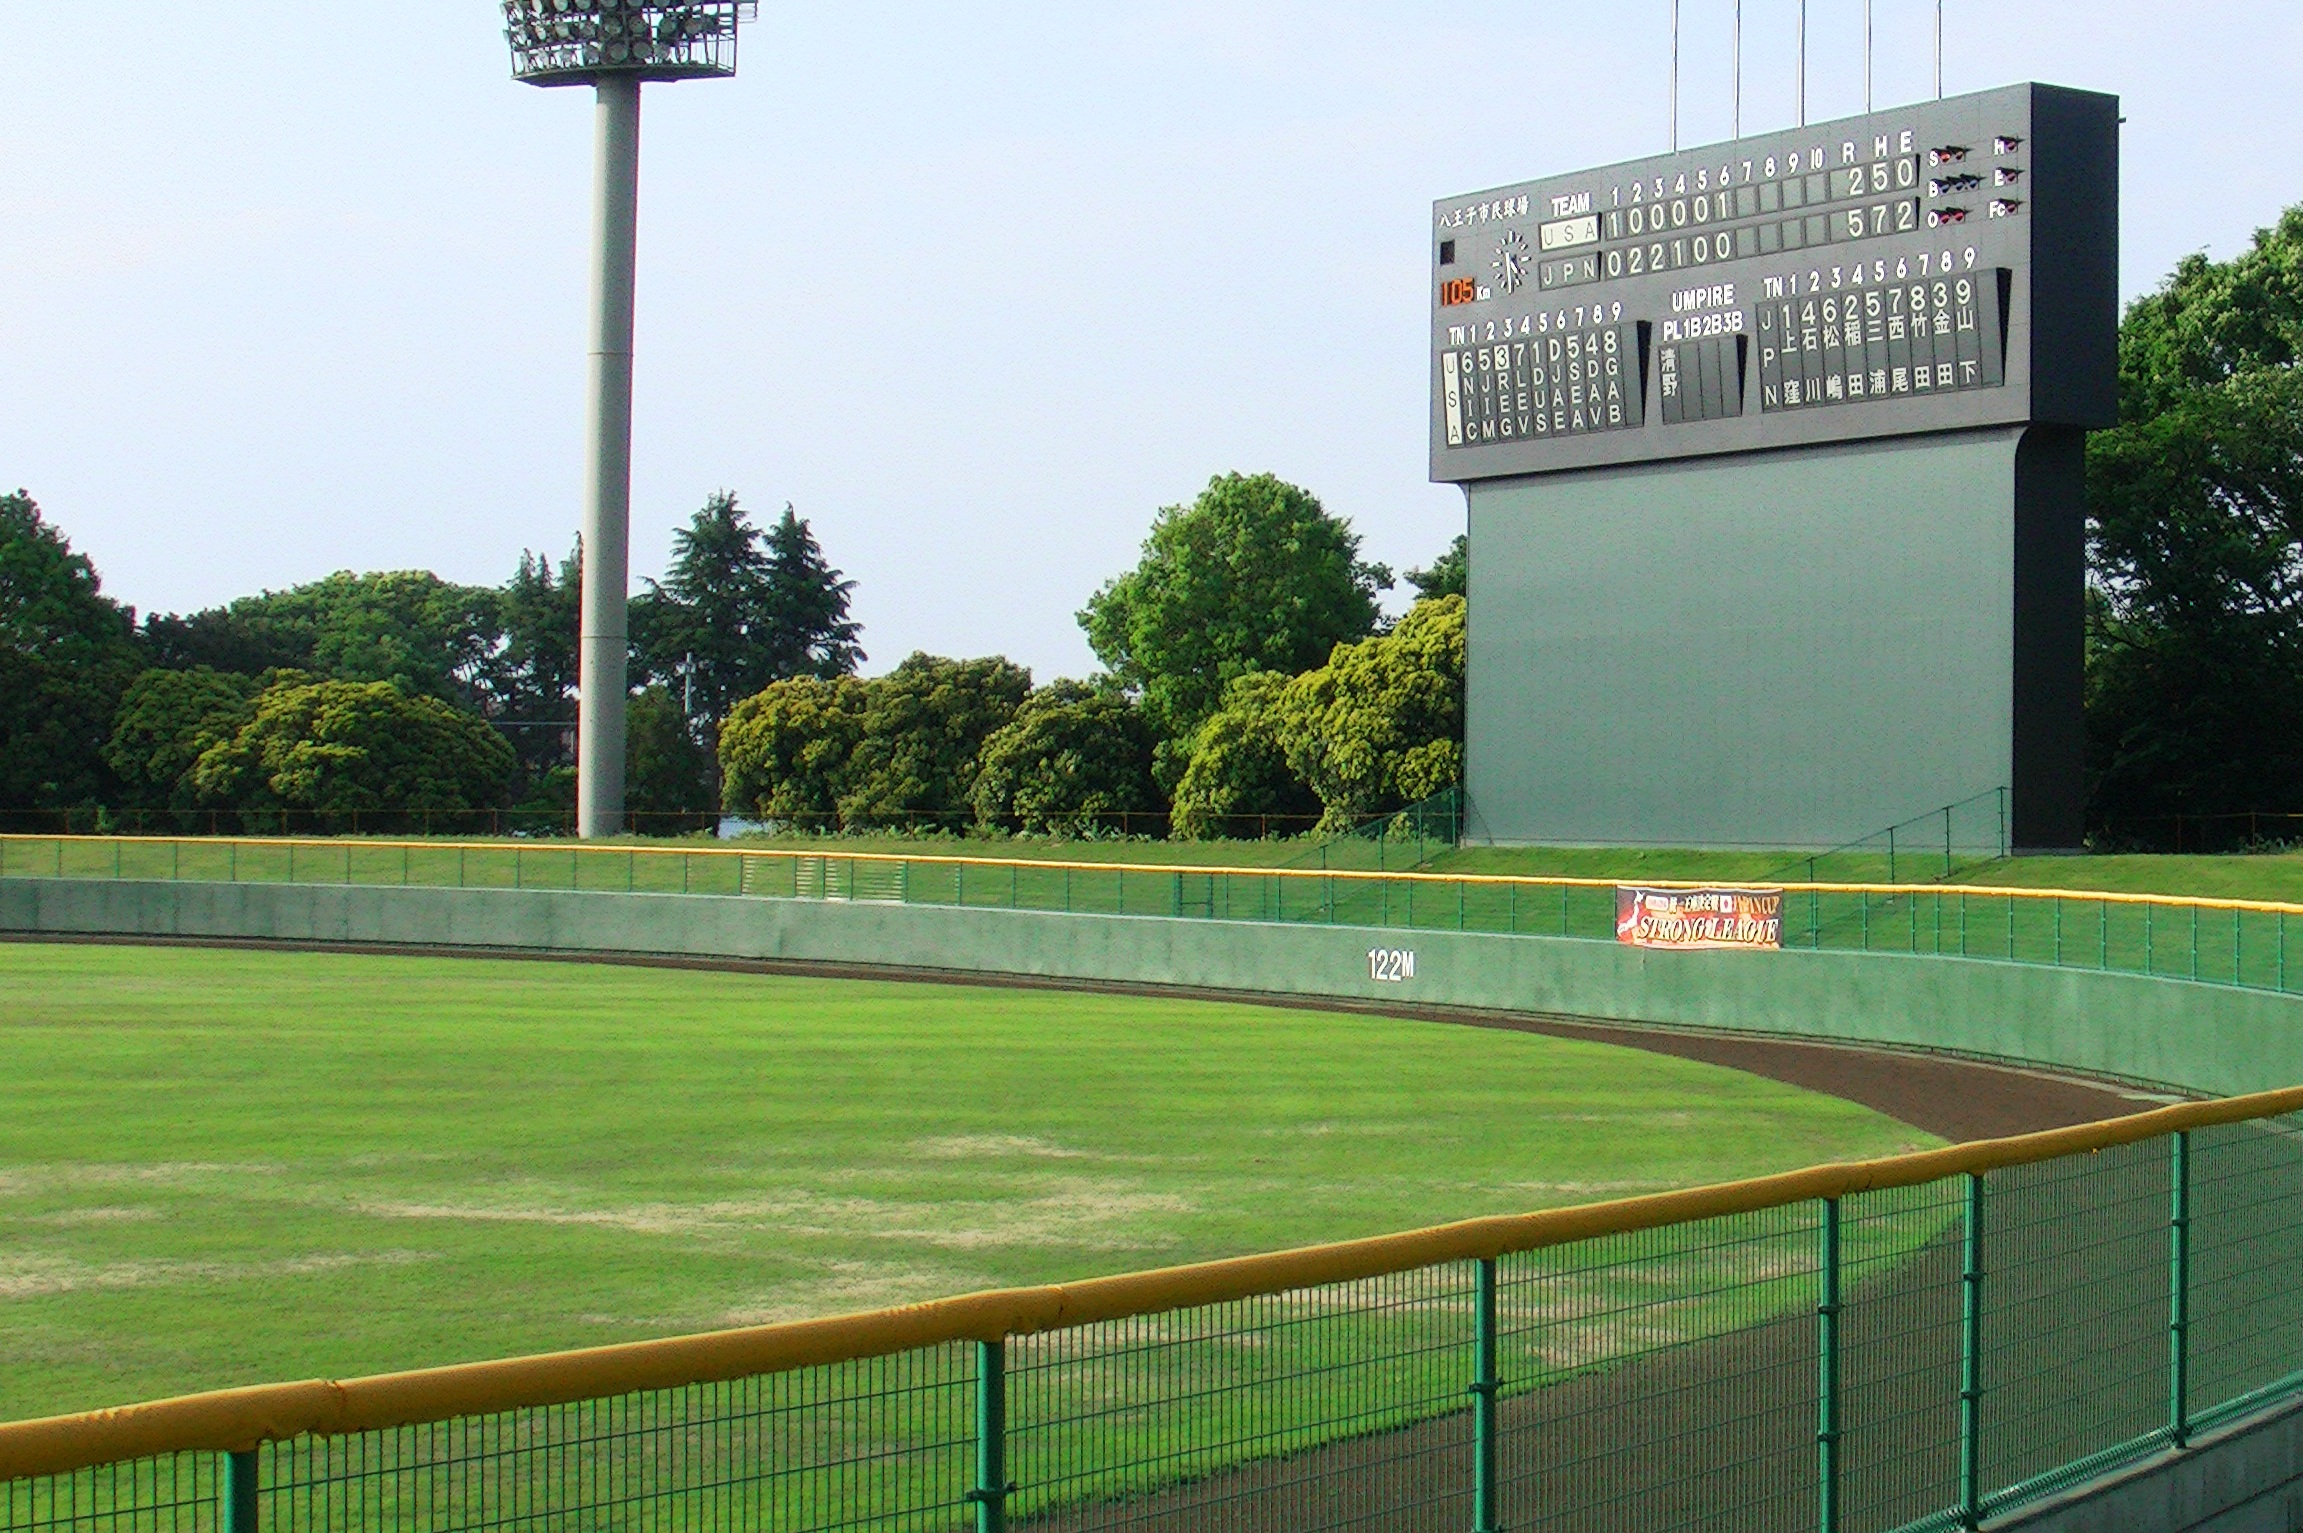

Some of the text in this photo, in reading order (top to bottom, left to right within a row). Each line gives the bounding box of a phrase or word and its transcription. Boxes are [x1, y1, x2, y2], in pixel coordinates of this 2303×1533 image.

[1929, 151, 1939, 167] S
[1994, 139, 2005, 156] H
[1551, 131, 1912, 217] TEAM 1 2 3 4 5 6 7 8 9 10 R H E
[1994, 170, 2005, 187] E
[1929, 181, 1939, 198] B
[1440, 195, 1529, 228] 八王子市民球場
[1544, 159, 1912, 246] USA 1 0 0 0 0 1 2 5 0
[1543, 201, 1913, 285] JPN 0 2 2 1 0 0 5 7 2
[1764, 247, 1975, 298] TN 1 2 3 4 5 6 7 8 9
[1442, 278, 1473, 306] 105
[1672, 284, 1734, 312] UMPIRE
[1888, 288, 1901, 313] 7
[1910, 285, 1925, 311] 8
[1933, 282, 1948, 308] 3
[1955, 279, 1971, 304] 9
[1782, 304, 1790, 328] 1
[1802, 301, 1816, 326] 4
[1823, 298, 1837, 322] 6
[1845, 295, 1858, 320] 2
[1866, 292, 1880, 317] 5
[1449, 302, 1621, 345] TN 1 2 3 4 5 6 7 8 9
[1664, 311, 1743, 341] PL 1B 2B 3B
[1513, 343, 1525, 365] 7
[1533, 341, 1540, 363] 1
[1549, 339, 1561, 361] D
[1567, 336, 1580, 358] 5
[1586, 333, 1598, 355] 4
[1604, 330, 1617, 353] 8
[1462, 352, 1473, 373] 6
[1479, 349, 1491, 370] 5
[1495, 347, 1507, 368] 3
[1762, 311, 1778, 405] JPN
[1446, 357, 1460, 441] USA
[1638, 916, 1778, 943] STRONG LEAGUE
[1367, 949, 1414, 981] 122M
